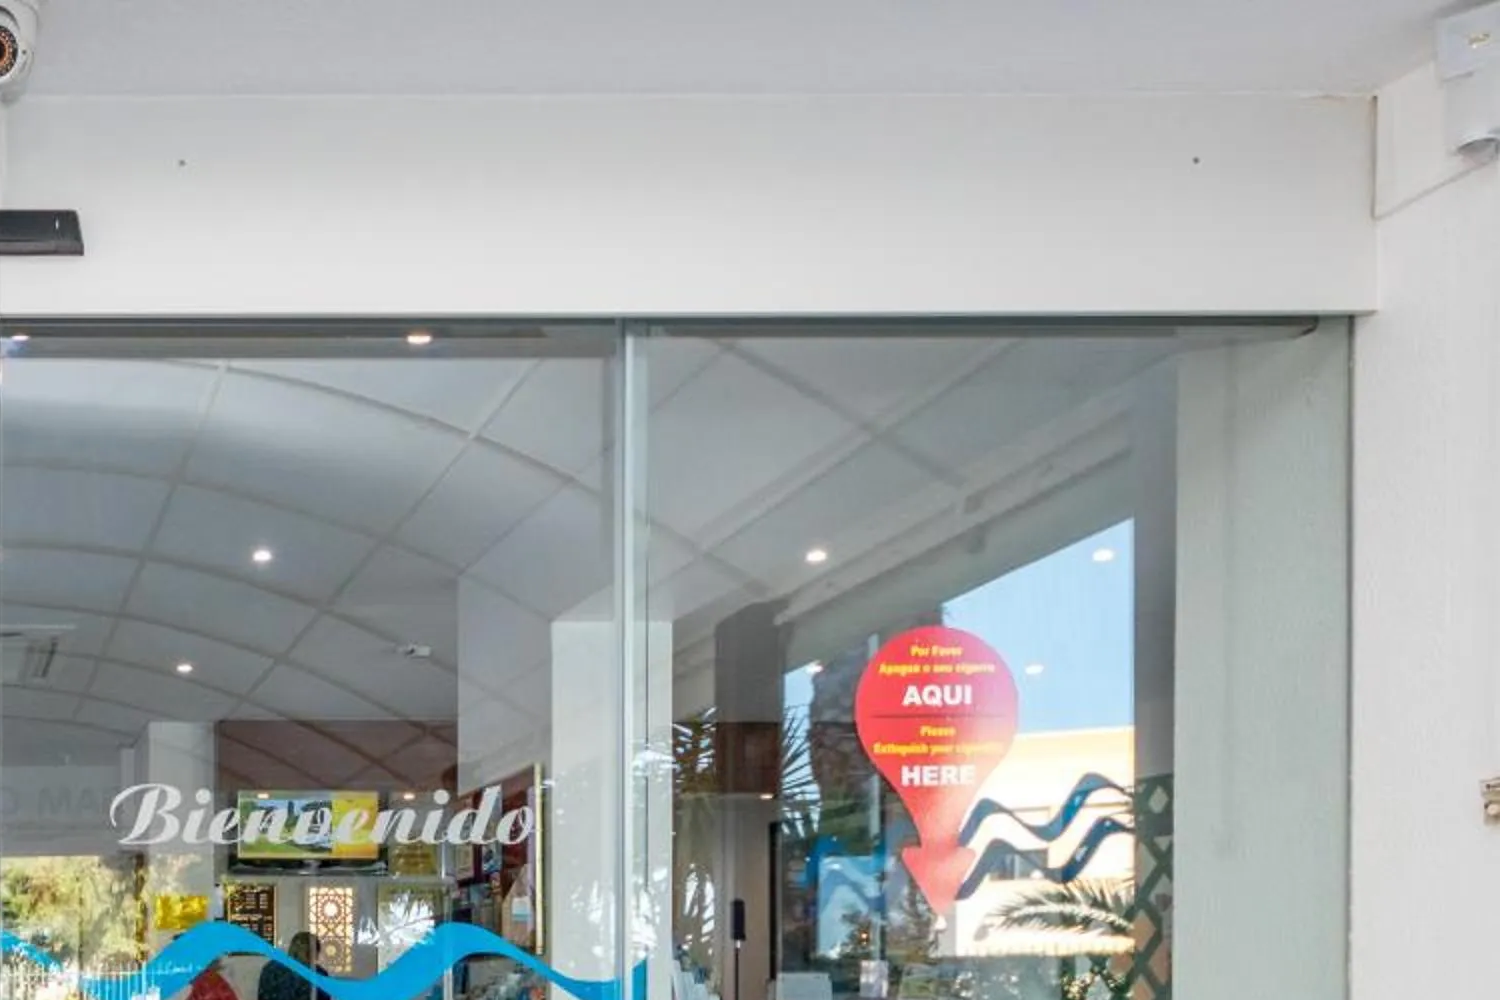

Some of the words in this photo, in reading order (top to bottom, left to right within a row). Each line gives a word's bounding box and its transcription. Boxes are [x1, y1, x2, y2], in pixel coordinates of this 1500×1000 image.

[902, 684, 973, 707] AQUI
[901, 765, 976, 787] HERE
[109, 783, 537, 846] Bienvenido
